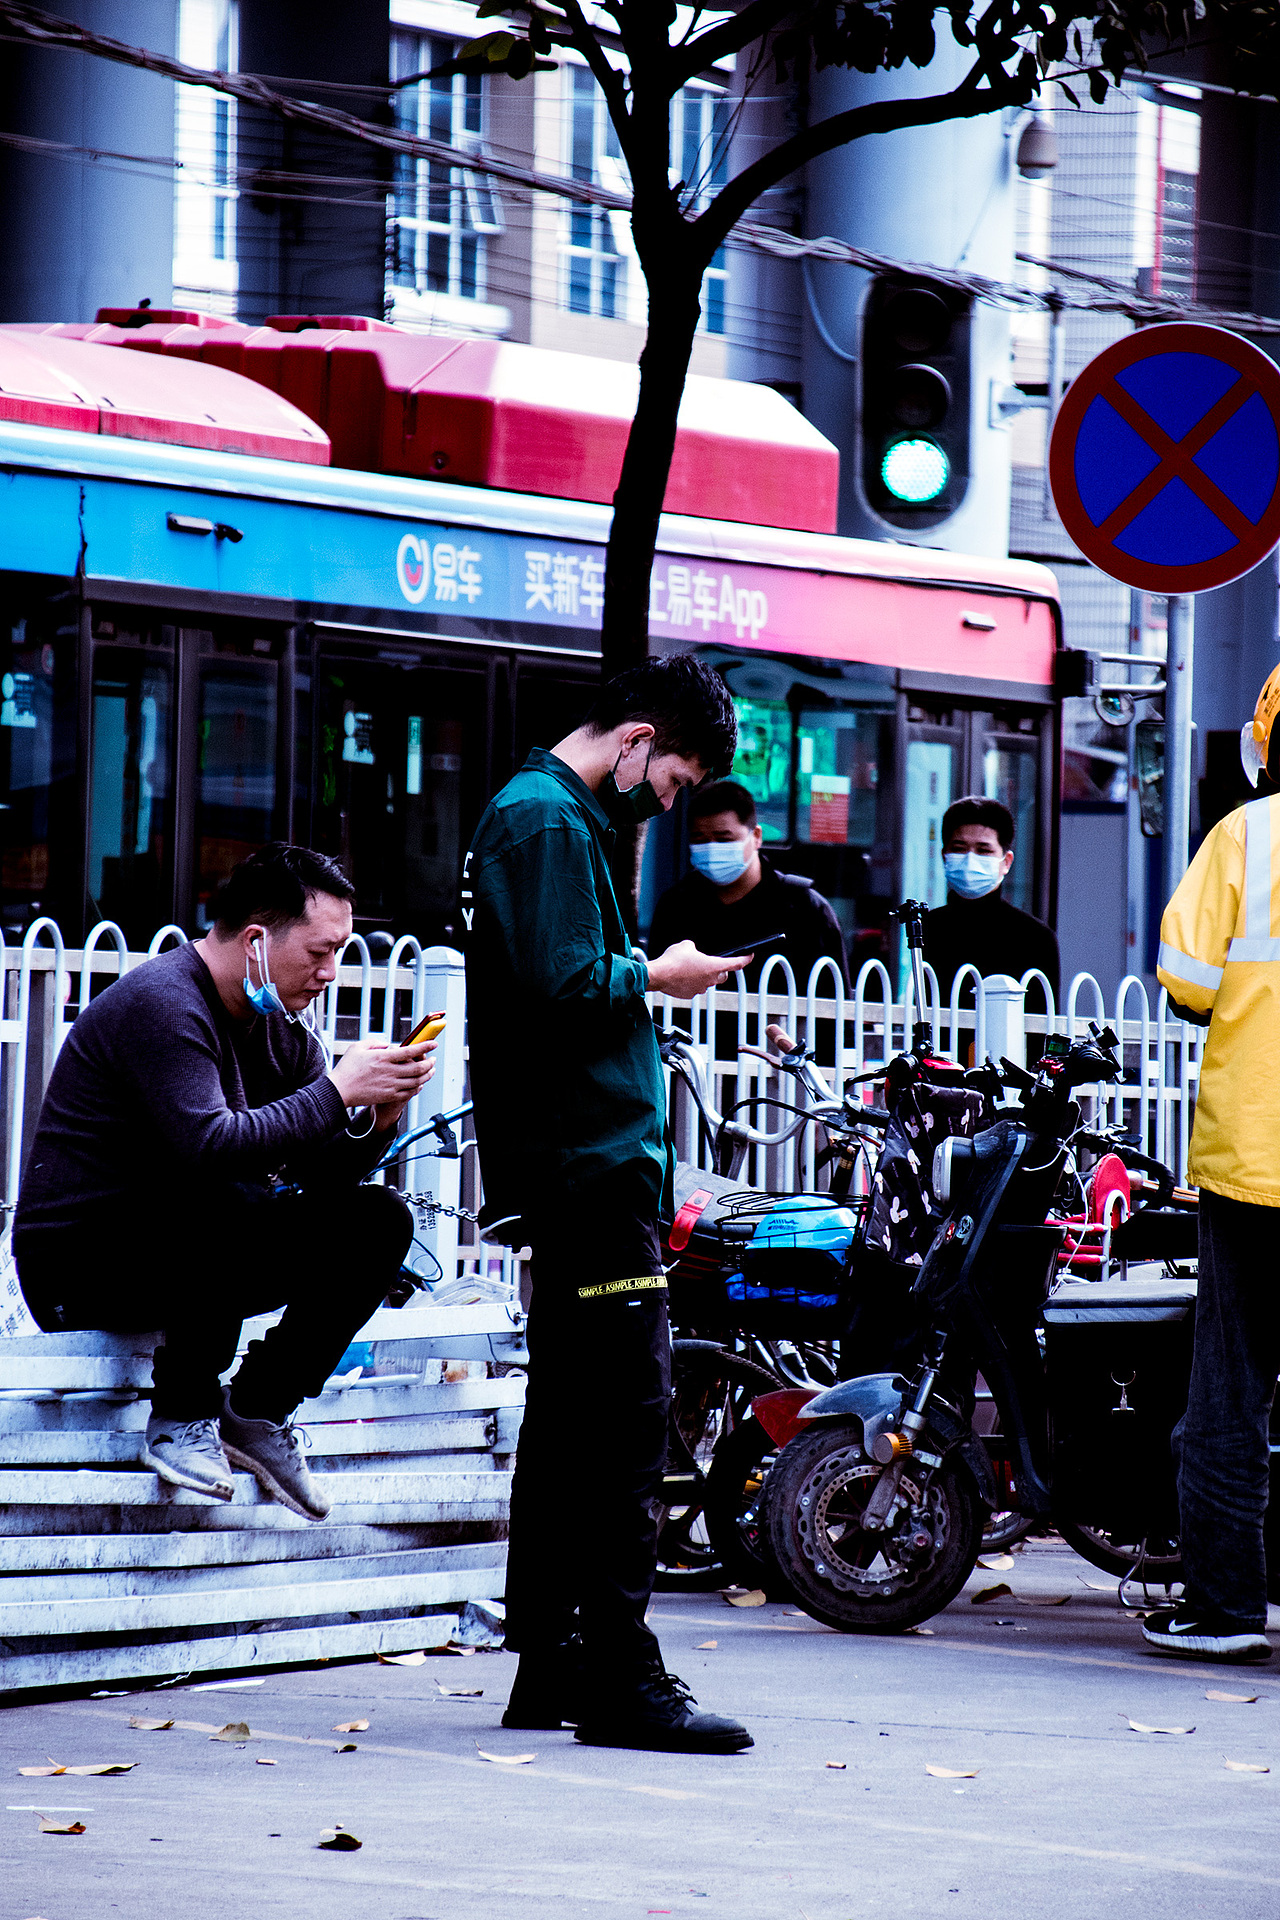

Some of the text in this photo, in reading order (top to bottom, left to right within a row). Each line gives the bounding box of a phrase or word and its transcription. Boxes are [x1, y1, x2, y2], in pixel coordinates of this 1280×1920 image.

[432, 543, 483, 604] 易车
[525, 550, 605, 618] 买新车
